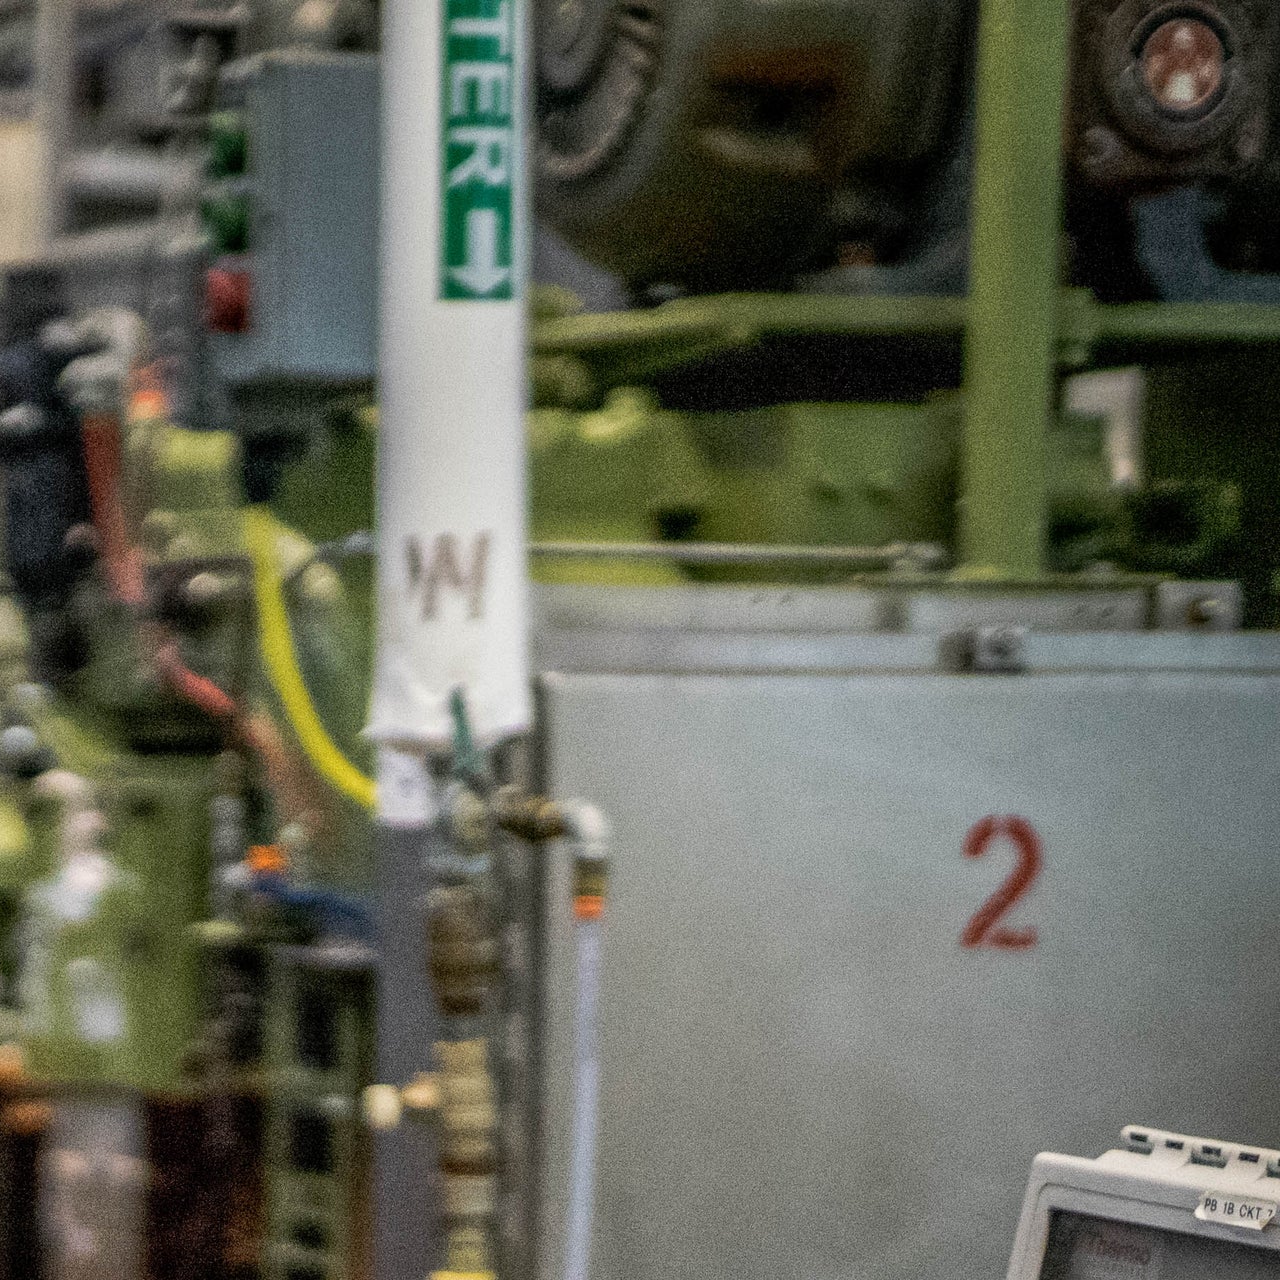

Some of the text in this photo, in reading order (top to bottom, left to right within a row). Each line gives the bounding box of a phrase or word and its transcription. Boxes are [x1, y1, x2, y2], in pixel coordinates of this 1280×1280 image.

[960, 813, 1044, 952] 2
[1204, 1197, 1218, 1212] PB
[1239, 1204, 1262, 1220] CKT
